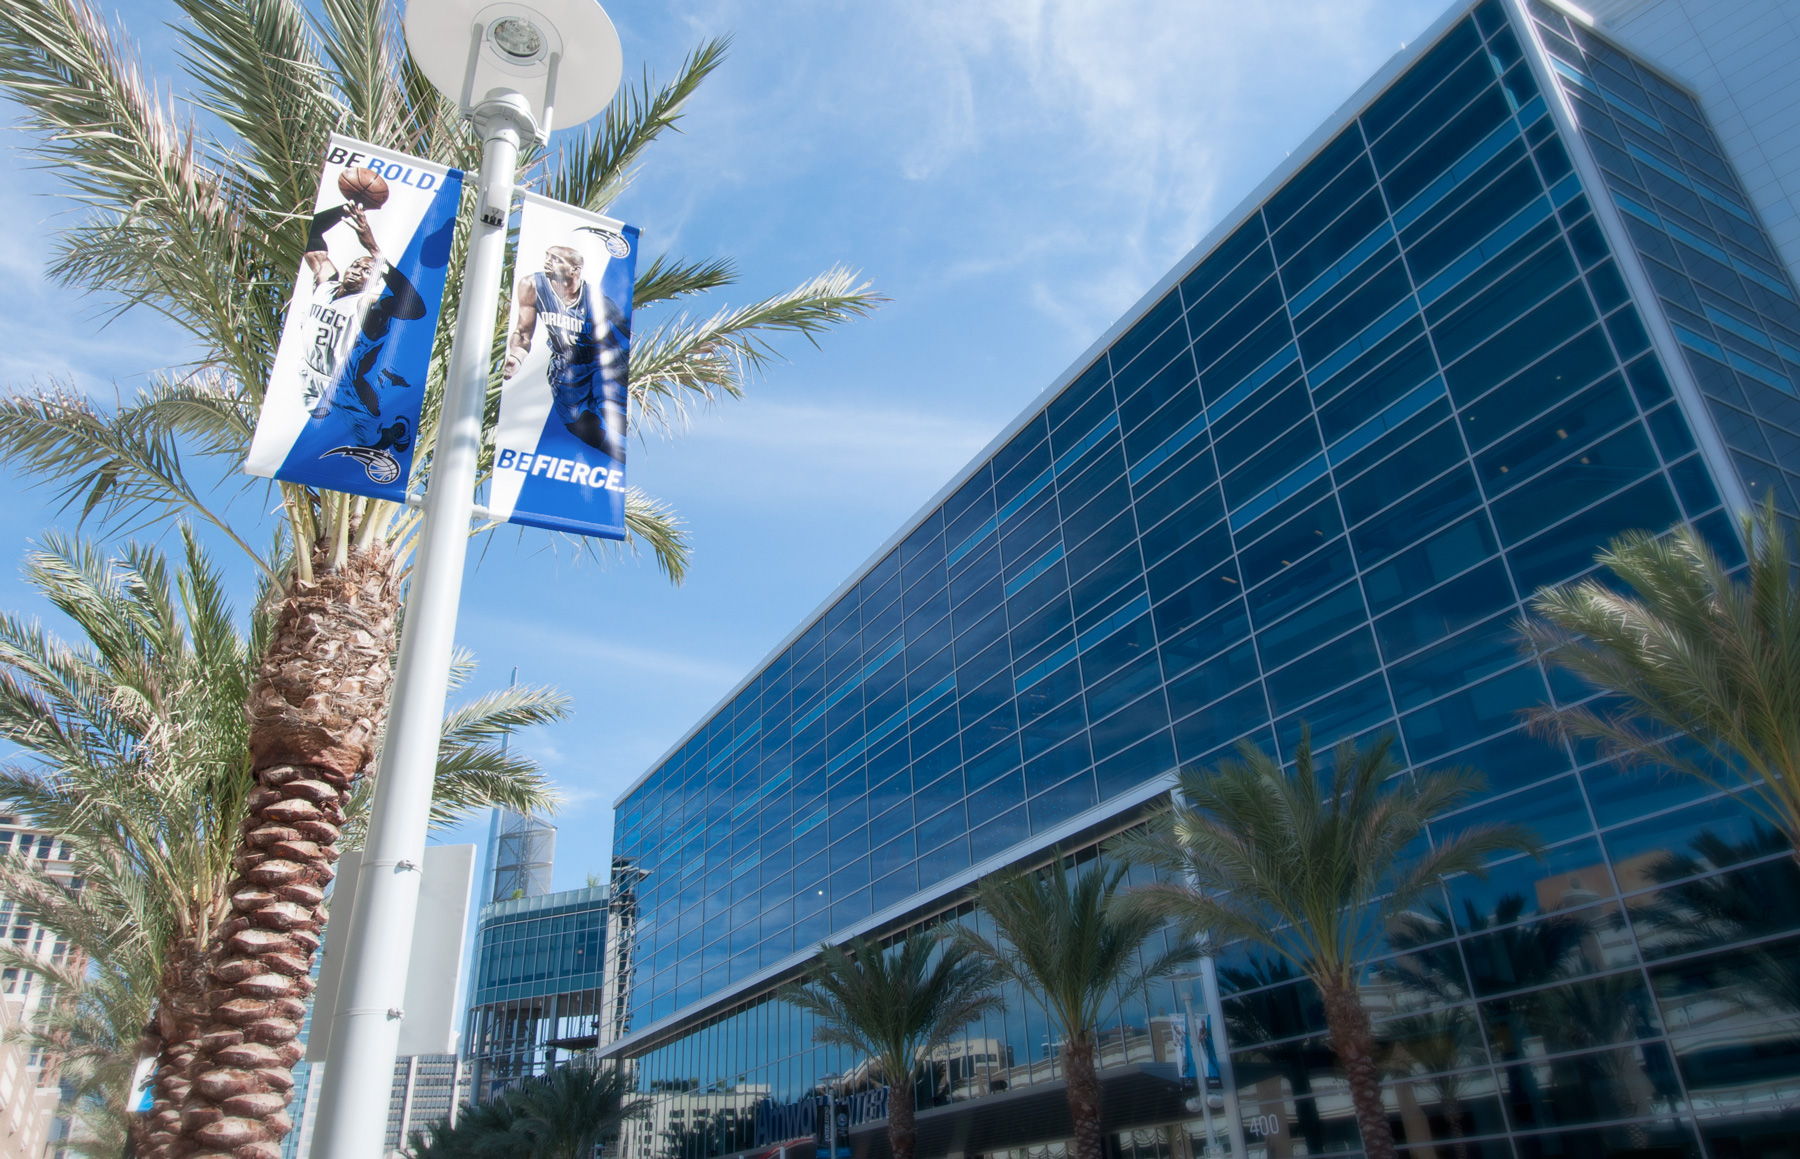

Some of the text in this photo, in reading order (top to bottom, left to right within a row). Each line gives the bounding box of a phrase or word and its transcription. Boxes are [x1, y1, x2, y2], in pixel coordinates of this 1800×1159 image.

[327, 147, 365, 168] BE
[496, 448, 625, 493] BE FIERCE.
[1250, 1114, 1279, 1137] 400
